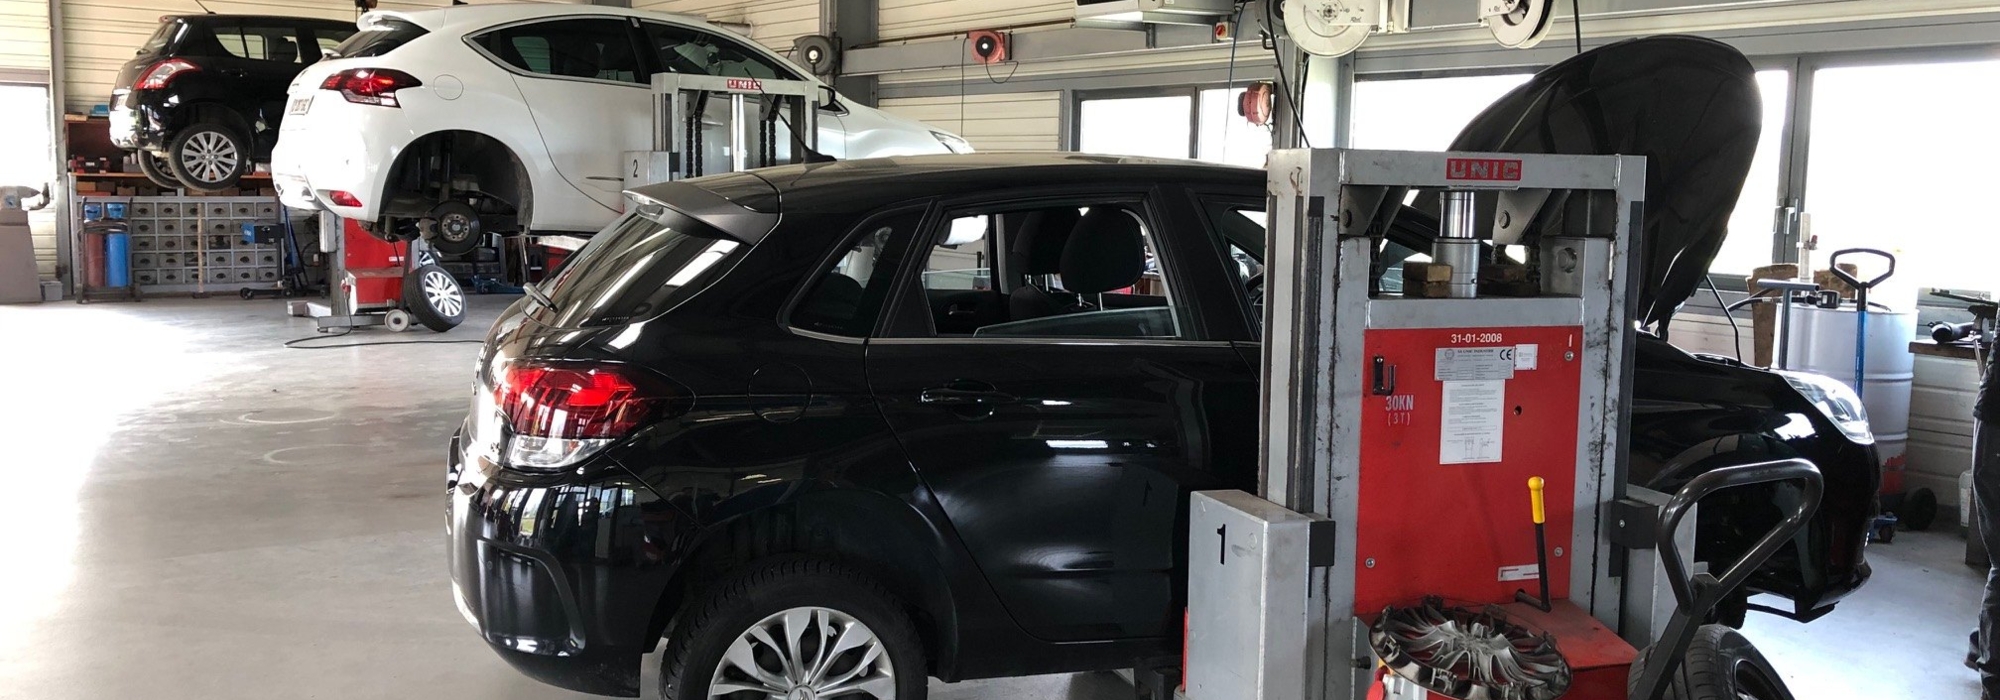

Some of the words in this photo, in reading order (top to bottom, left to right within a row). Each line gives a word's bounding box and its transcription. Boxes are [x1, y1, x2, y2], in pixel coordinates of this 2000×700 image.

[633, 159, 638, 178] 2
[1450, 161, 1519, 179] UNIC
[1451, 333, 1502, 343] 31-01-2008
[1500, 349, 1512, 360] CE
[1385, 395, 1414, 411] 30KN
[1217, 523, 1226, 566] 1
